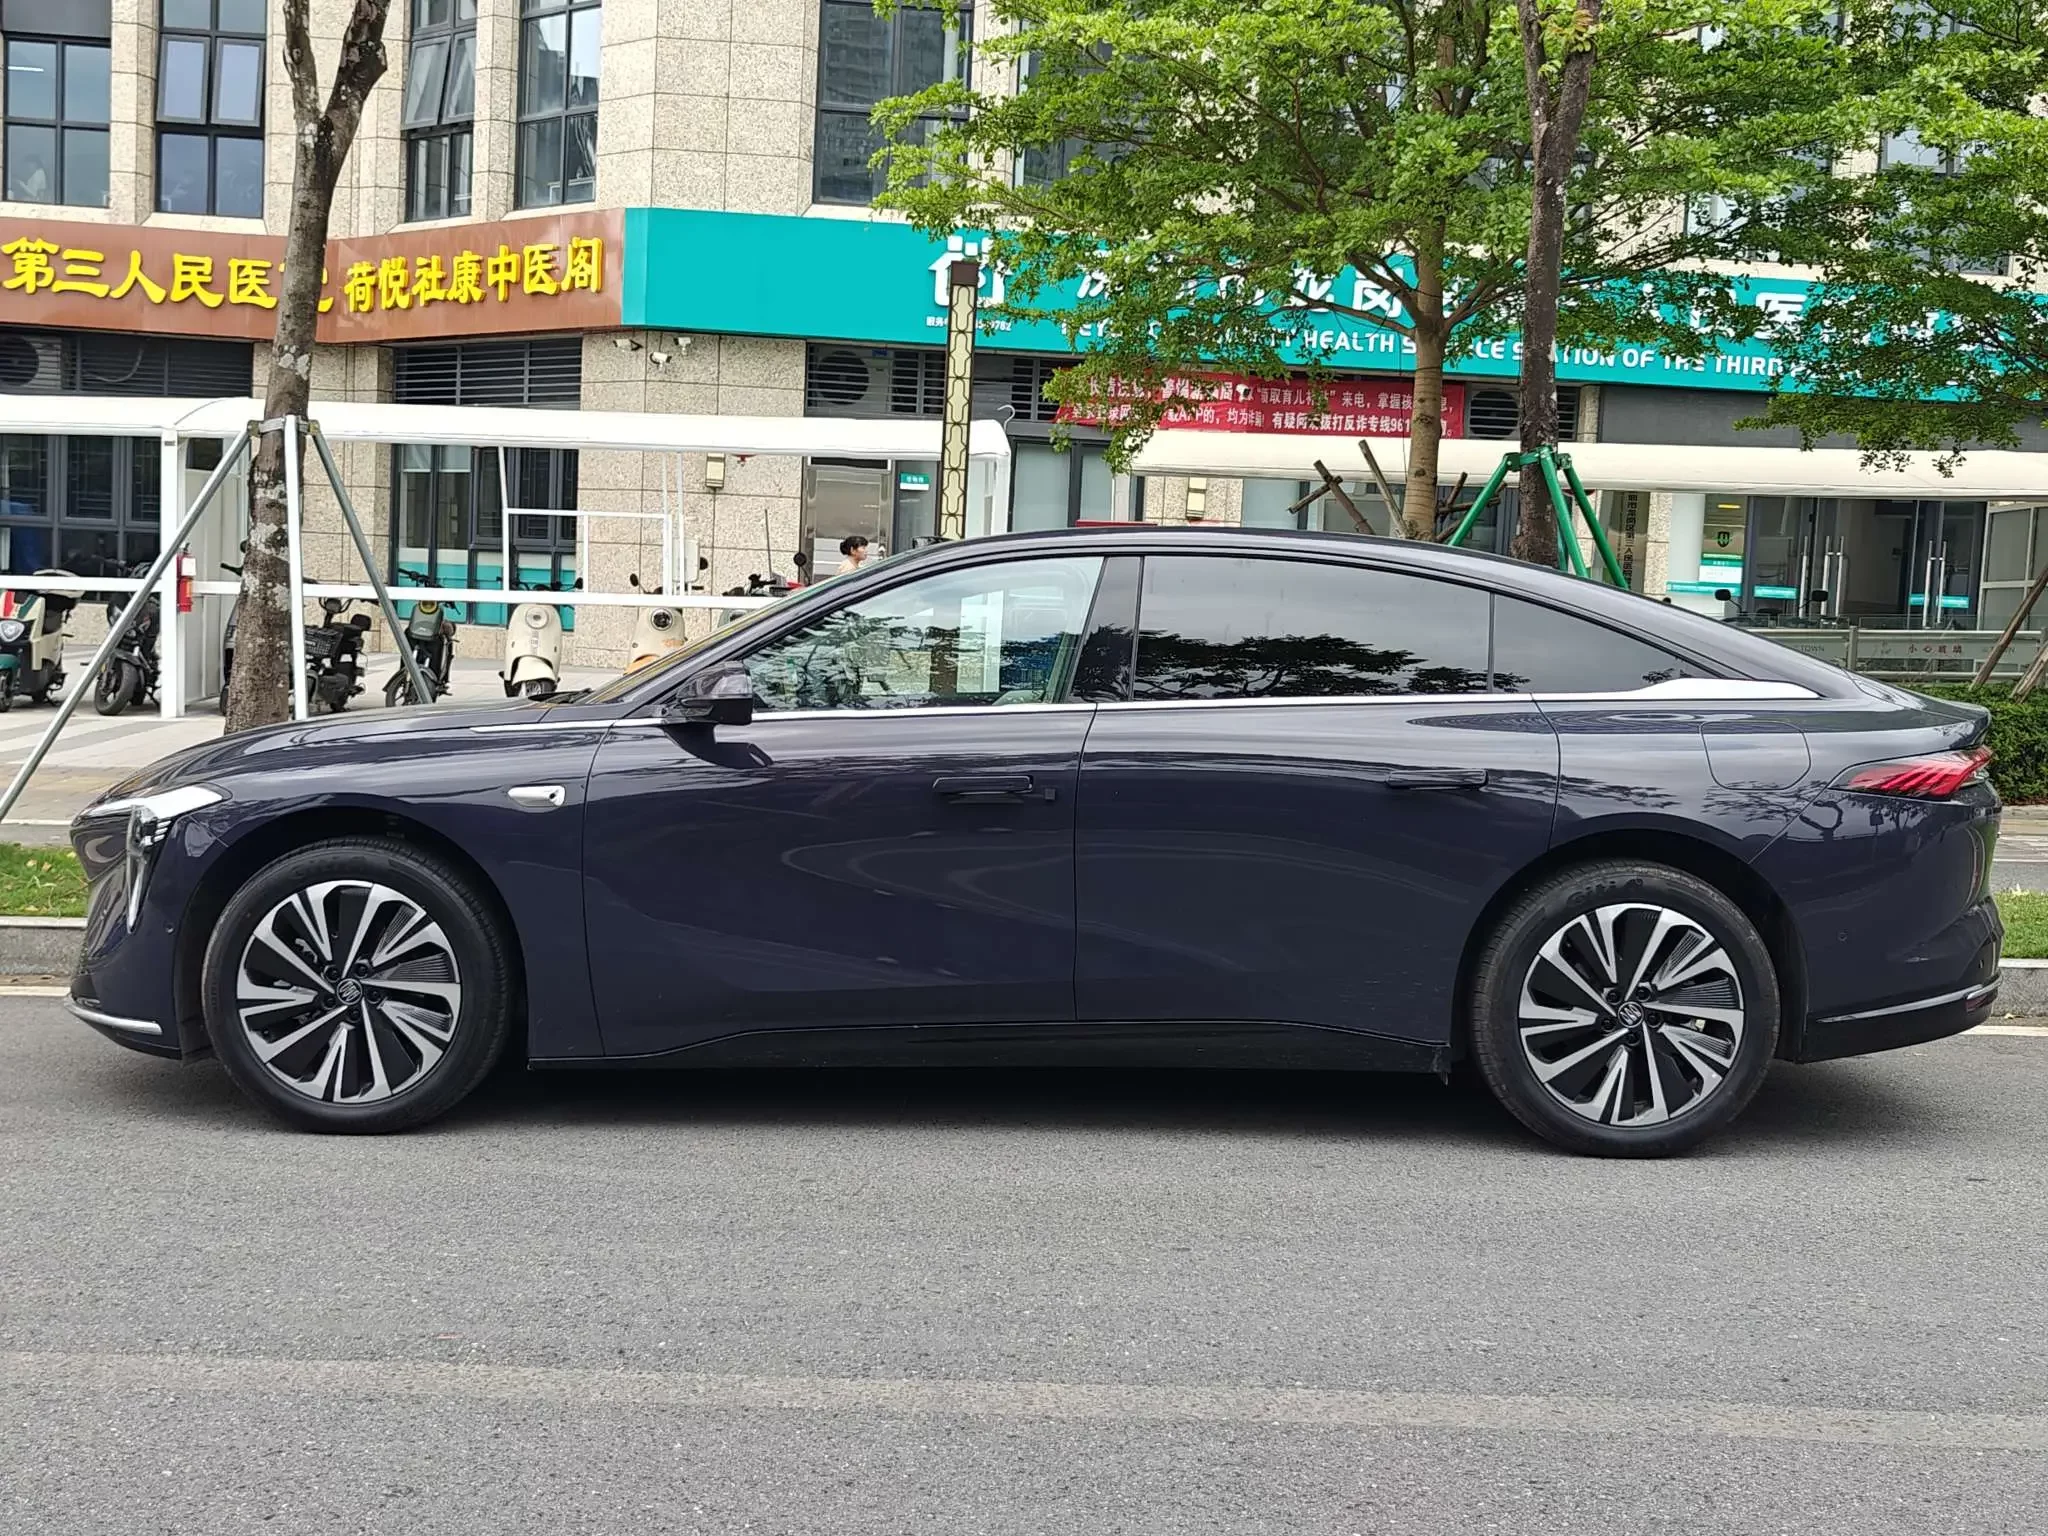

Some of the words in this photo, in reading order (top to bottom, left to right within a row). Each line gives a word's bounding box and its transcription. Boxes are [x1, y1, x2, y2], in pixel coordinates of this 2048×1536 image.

[0, 236, 334, 312] 第三人民医
[344, 236, 604, 313] 荷悦社康中医阁
[1303, 329, 1395, 353] HEALTH
[1511, 341, 1616, 367] STION
[1622, 348, 1655, 368] OF
[1715, 354, 1783, 377] THIRD
